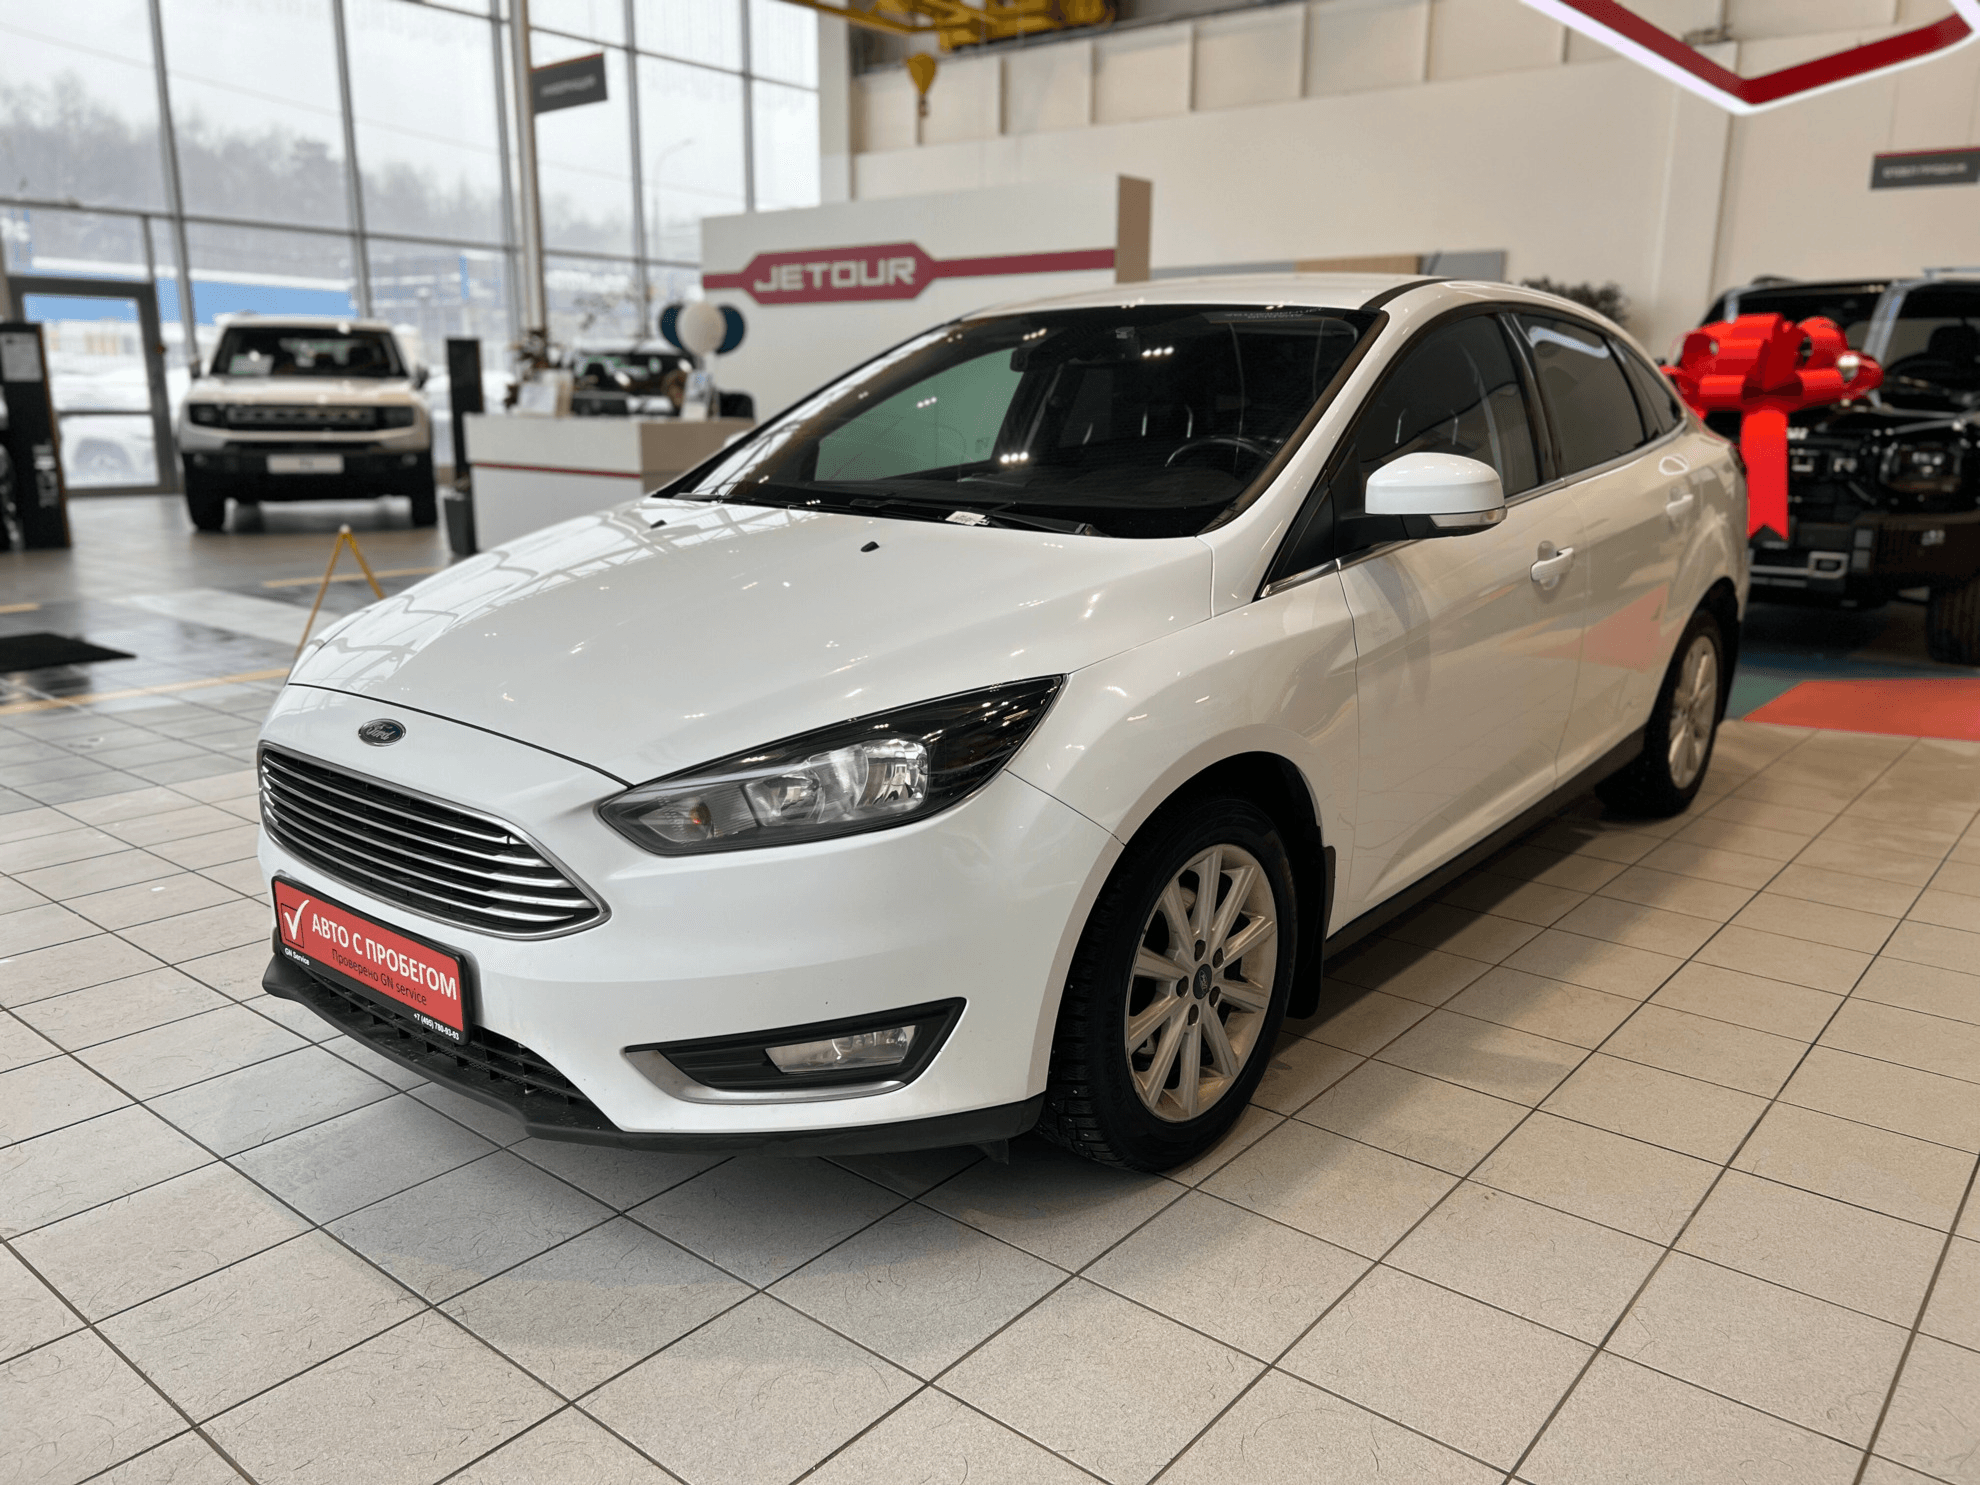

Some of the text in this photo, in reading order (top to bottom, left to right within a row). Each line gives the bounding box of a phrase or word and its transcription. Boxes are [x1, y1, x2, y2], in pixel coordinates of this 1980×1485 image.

[753, 256, 916, 293] JETOUR
[366, 724, 396, 740] Ford
[312, 913, 457, 1000] АВТО С ПРОБЕГОМ
[332, 948, 427, 1006] Проверено GN service
